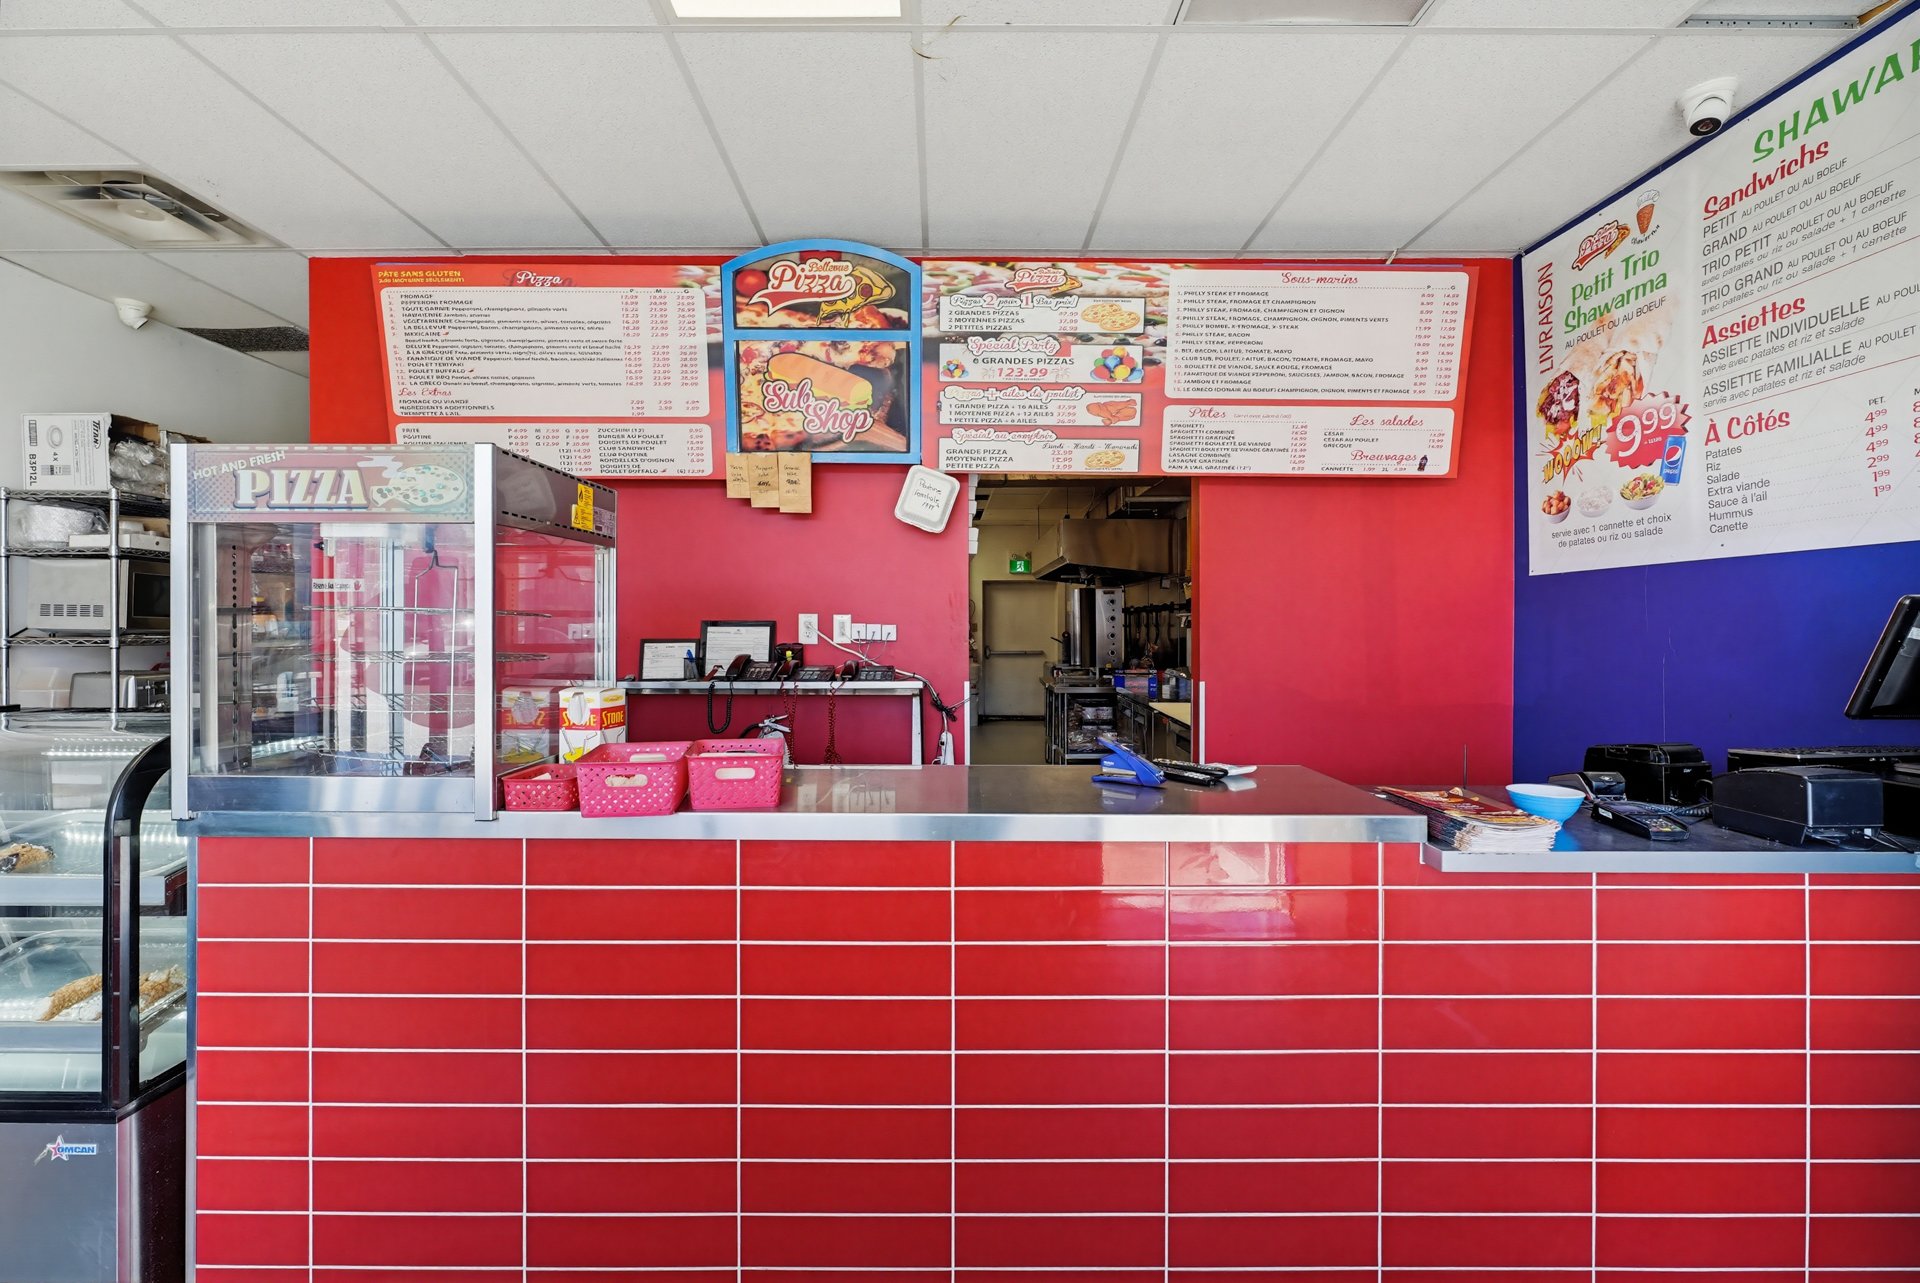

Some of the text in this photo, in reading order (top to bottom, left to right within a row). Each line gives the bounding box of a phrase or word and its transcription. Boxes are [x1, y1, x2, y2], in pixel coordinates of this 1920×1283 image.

[1703, 141, 1829, 221] Sandwichs
[1703, 157, 1848, 238] PETIT AU POULET OU AU BOEUF
[1703, 172, 1862, 257] GRAND AU POULET OU AU BOEUF
[1702, 181, 1894, 276] TRIO PETIT AU POULET OU AU BOEUF
[1701, 210, 1908, 306] TRIO GRAND AU POULET OU AU BOEUF
[516, 271, 563, 286] Pizza
[771, 264, 844, 294] Pizza
[1281, 272, 1358, 283] Sous-marins
[1571, 249, 1660, 306] Petit Trio
[985, 296, 994, 306] 2
[1024, 294, 1030, 305] 1
[1564, 272, 1668, 335] Shawarma
[1538, 262, 1553, 374] LIVRAISON
[1565, 296, 1667, 350] AU POULET OU AU BOEUF
[1701, 297, 1806, 349] Assiettes
[1702, 334, 1762, 366] ASSIETTE
[1766, 296, 1871, 344] INDIVIDUELLE
[1876, 294, 1891, 306] AU
[1021, 339, 1057, 354] Party
[1702, 317, 1865, 377] servie avec patates et riz et salade
[998, 368, 1048, 377] 123.99
[1037, 357, 1075, 365] PIZZAS
[1703, 325, 1916, 397] ASSIETTE FAMILIALLE AU POULET
[764, 380, 812, 411] Sub
[804, 400, 869, 440] Shop
[1188, 407, 1226, 418] Pâtes
[1380, 415, 1424, 426] salades
[1704, 409, 1791, 446] À Côtés
[193, 450, 286, 480] HOT AND FRESH
[1350, 450, 1417, 465] Breuvages
[1705, 445, 1742, 460] Patates
[1706, 462, 1721, 472] Riz
[1706, 471, 1740, 485] Salade
[233, 469, 369, 509] PIZZA
[1707, 485, 1733, 497] Extra
[1736, 478, 1770, 493] viande
[1708, 498, 1739, 509] Sauce
[1741, 495, 1748, 504] à
[1751, 491, 1768, 502] l'ail
[1552, 528, 1572, 540] servie
[1573, 527, 1590, 536] avec
[1598, 519, 1634, 532] cannette
[1636, 517, 1645, 526] et
[1647, 514, 1672, 524] choix
[1709, 508, 1754, 522] Hummus
[1709, 521, 1749, 534] Canette
[1558, 527, 1664, 549] de patates ou riz ou salade
[602, 711, 624, 726] STONE
[57, 1146, 95, 1154] OMCAN
